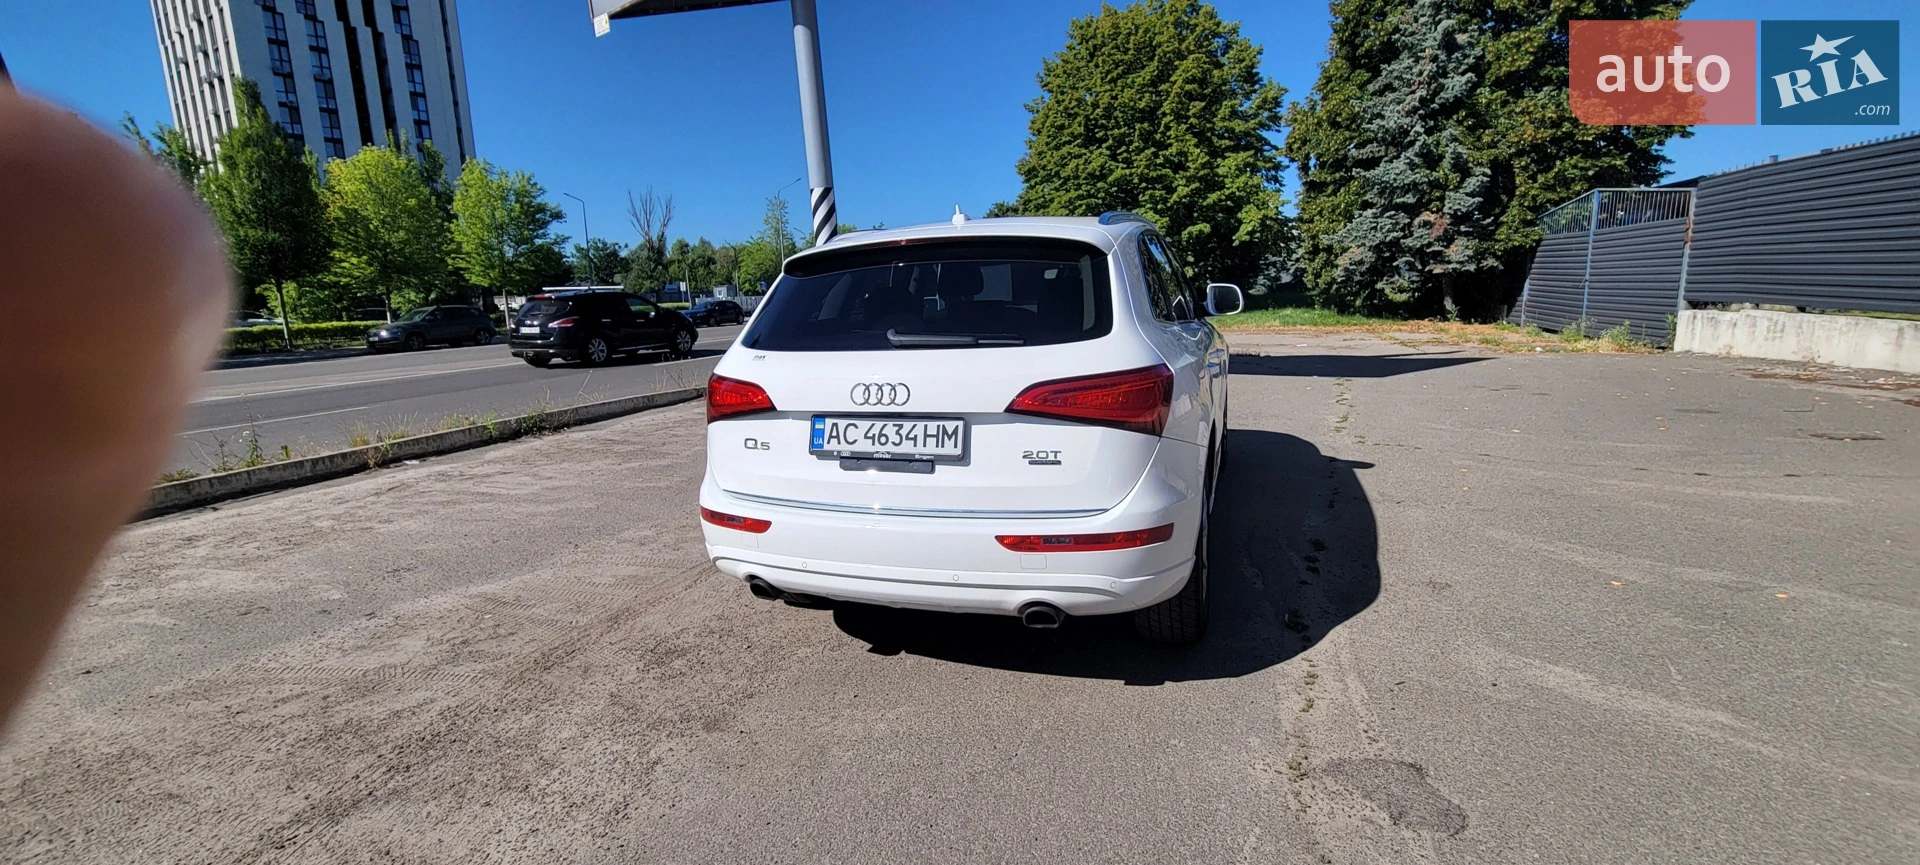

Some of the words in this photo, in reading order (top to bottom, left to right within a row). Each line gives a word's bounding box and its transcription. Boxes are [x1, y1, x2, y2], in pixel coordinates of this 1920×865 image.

[814, 437, 824, 445] UA
[827, 422, 858, 446] AC
[864, 423, 918, 448] 4634
[923, 424, 959, 449] HM
[744, 438, 771, 450] Q5
